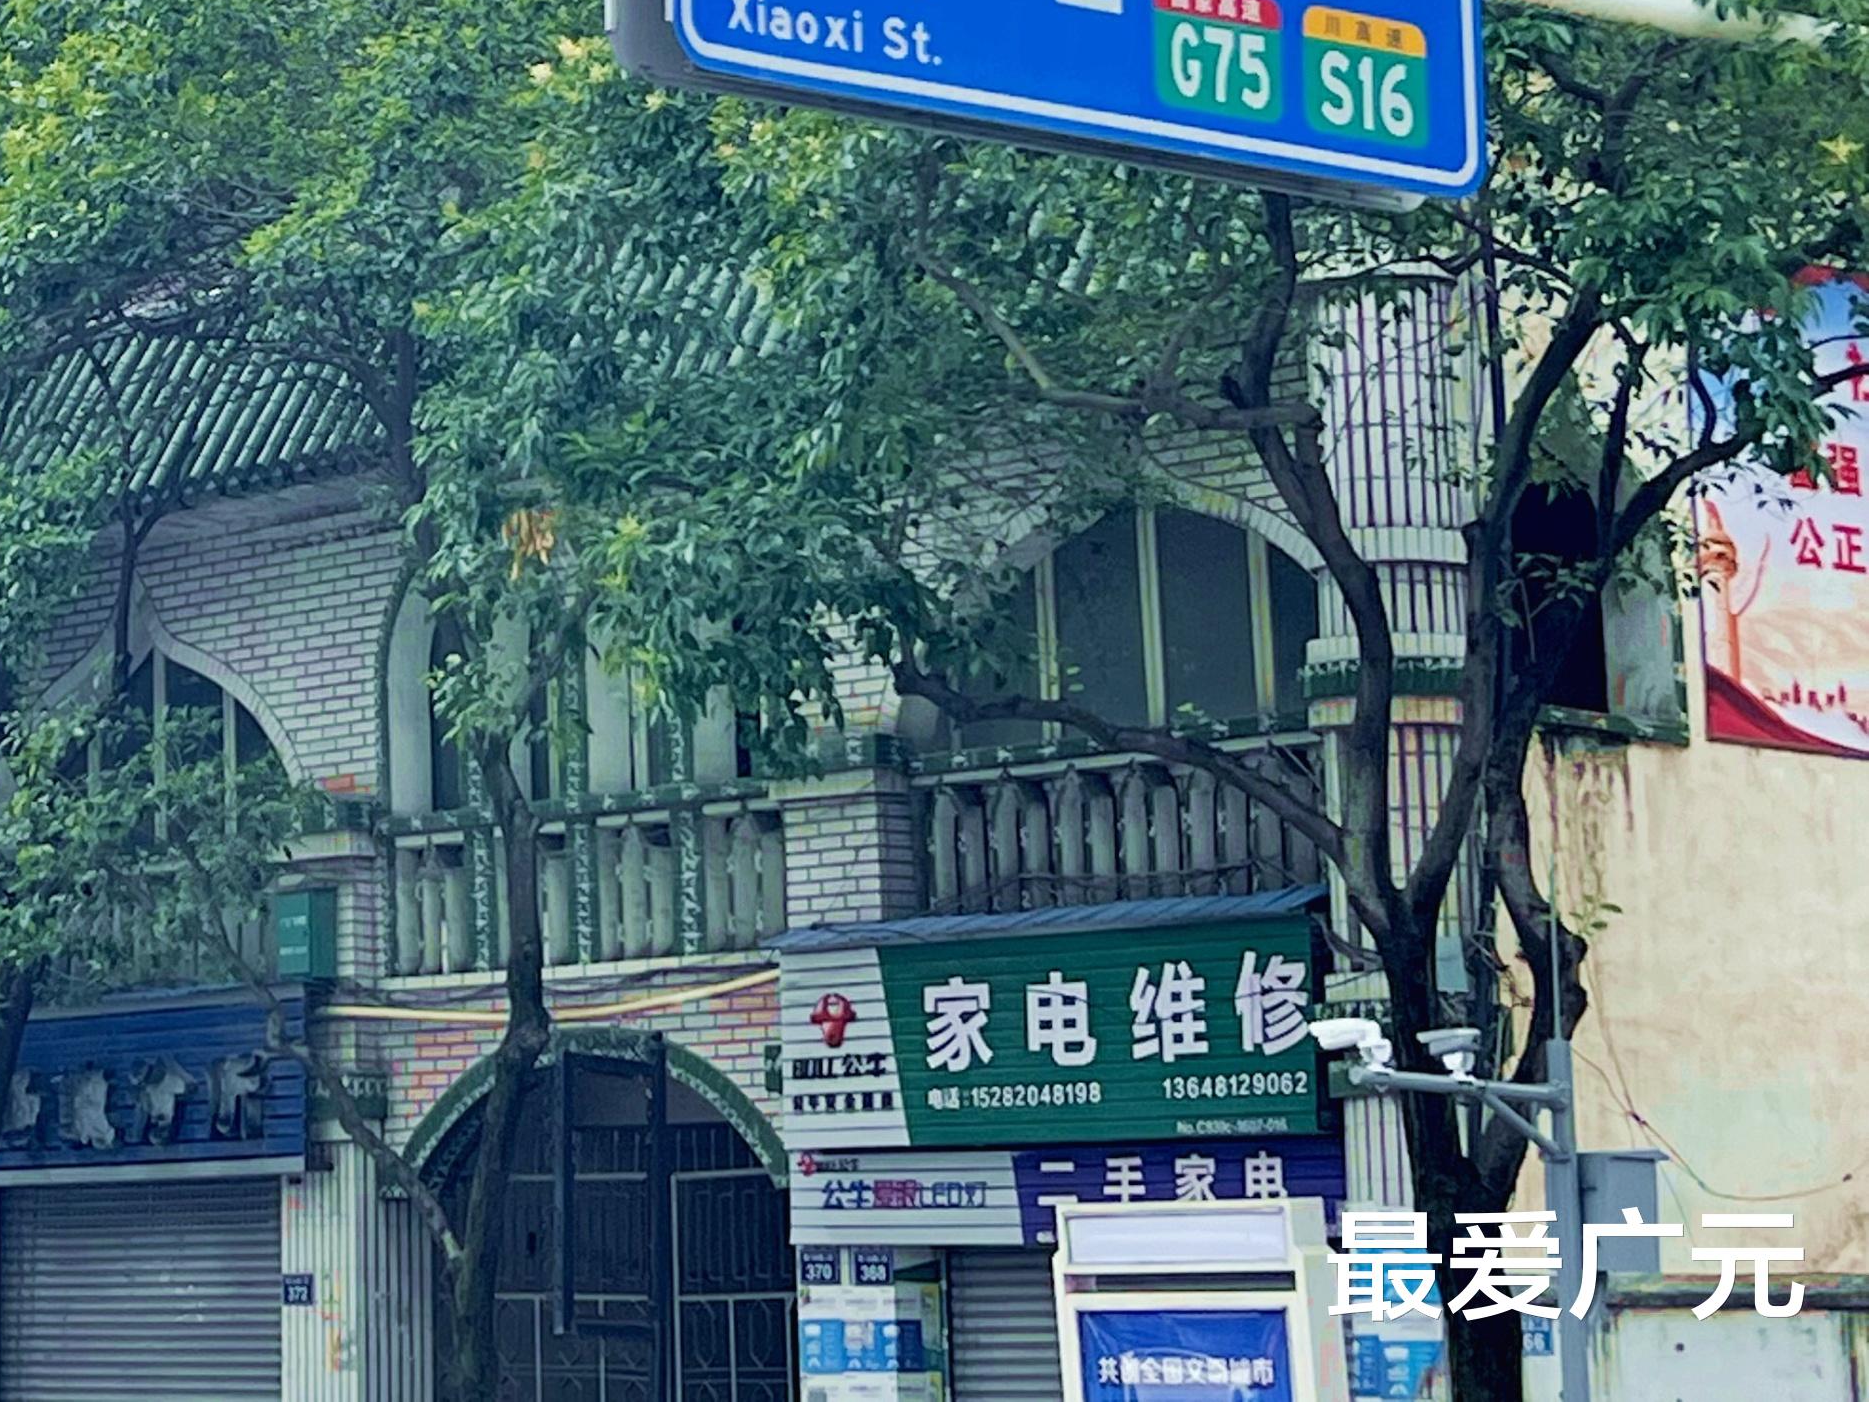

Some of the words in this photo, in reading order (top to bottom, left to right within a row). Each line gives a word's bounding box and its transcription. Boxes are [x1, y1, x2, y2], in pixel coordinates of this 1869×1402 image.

[883, 18, 943, 67] St.
[1325, 13, 1403, 49] 川高速
[1171, 21, 1271, 110] G75
[1320, 50, 1414, 137] S16
[1790, 517, 1867, 574] 公正
[923, 949, 1310, 1072] 家电维修
[1162, 1071, 1308, 1099] 13648129062
[1037, 1151, 1288, 1207] 二手家电
[805, 1264, 833, 1280] 370
